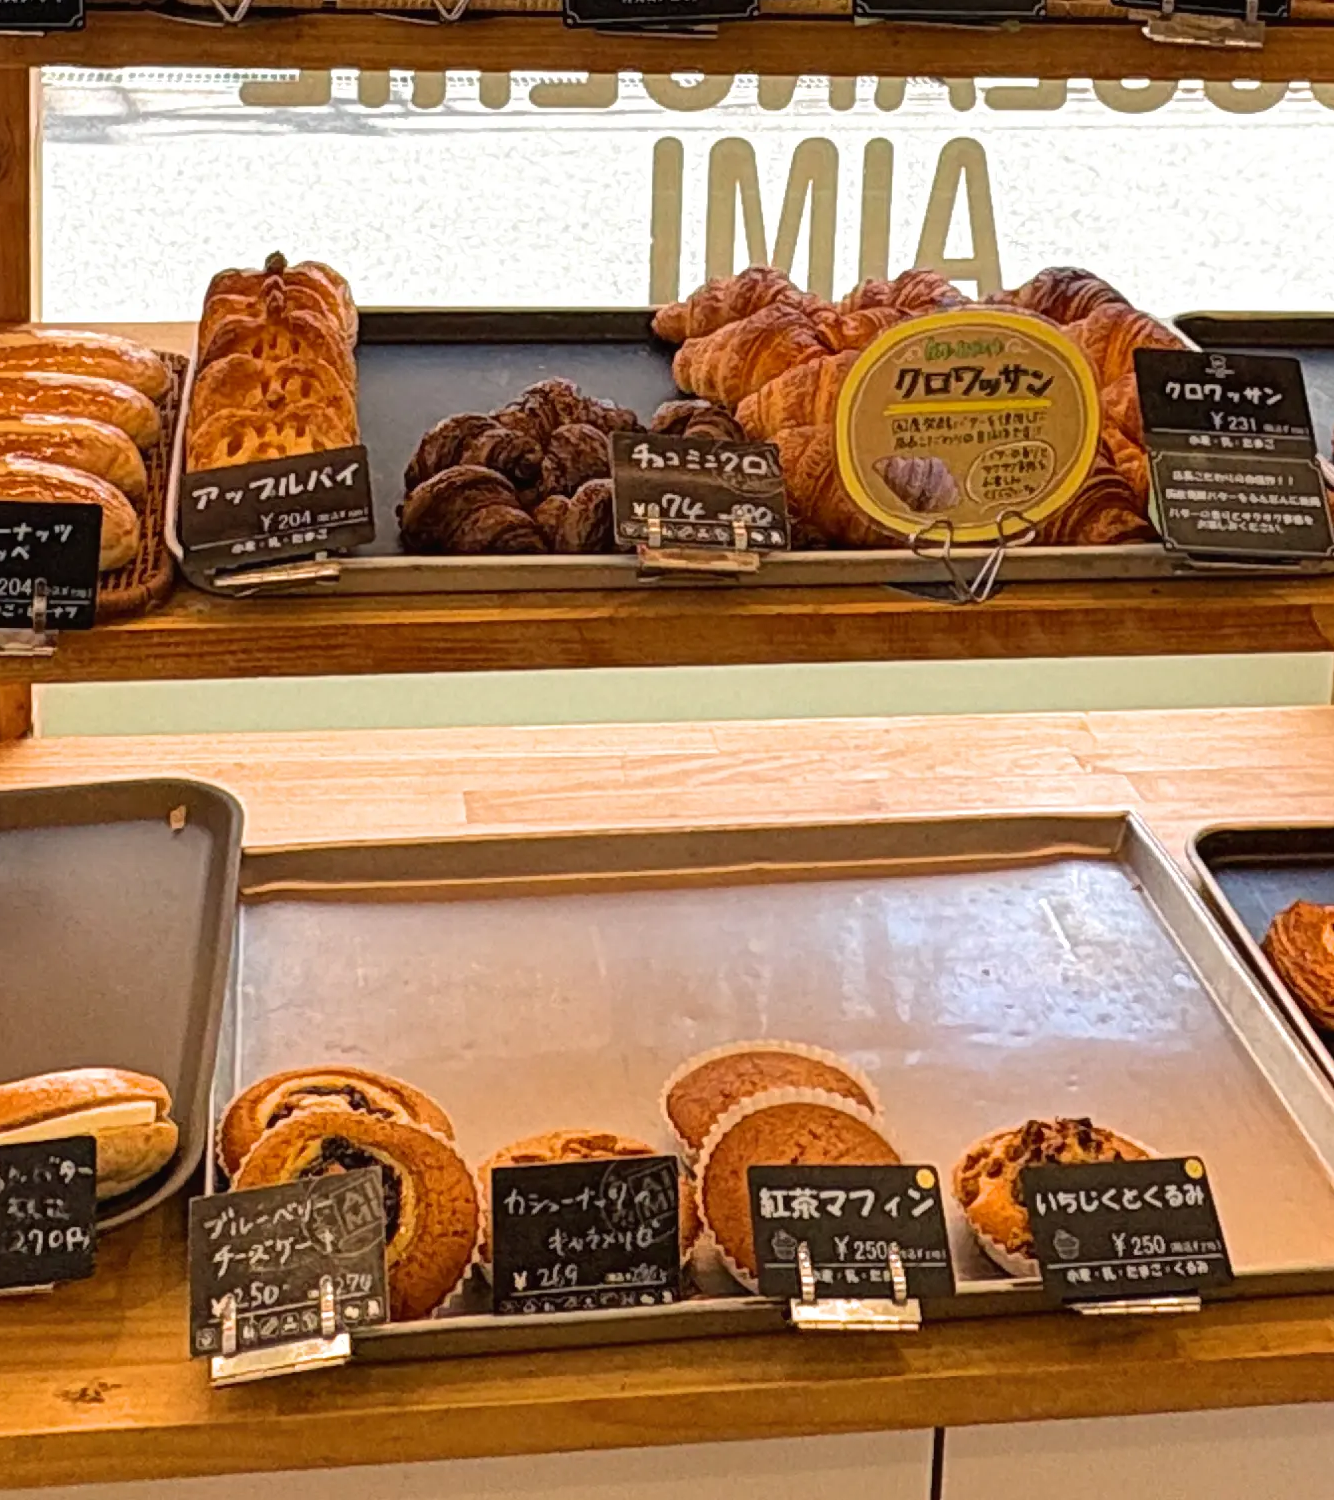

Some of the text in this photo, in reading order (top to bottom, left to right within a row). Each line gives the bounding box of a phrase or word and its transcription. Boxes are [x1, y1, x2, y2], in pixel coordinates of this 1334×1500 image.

[894, 363, 1056, 399] クロワッサン
[1165, 382, 1283, 405] クロワッサン
[1210, 411, 1258, 431] ¥231
[192, 462, 360, 510] アップルパイ
[261, 510, 312, 531] ¥204
[759, 1187, 935, 1219] 紅茶マフィン
[1035, 1183, 1205, 1217] いちじくとくるみ
[833, 1235, 888, 1261] ¥250
[1112, 1232, 1167, 1258] ¥250
